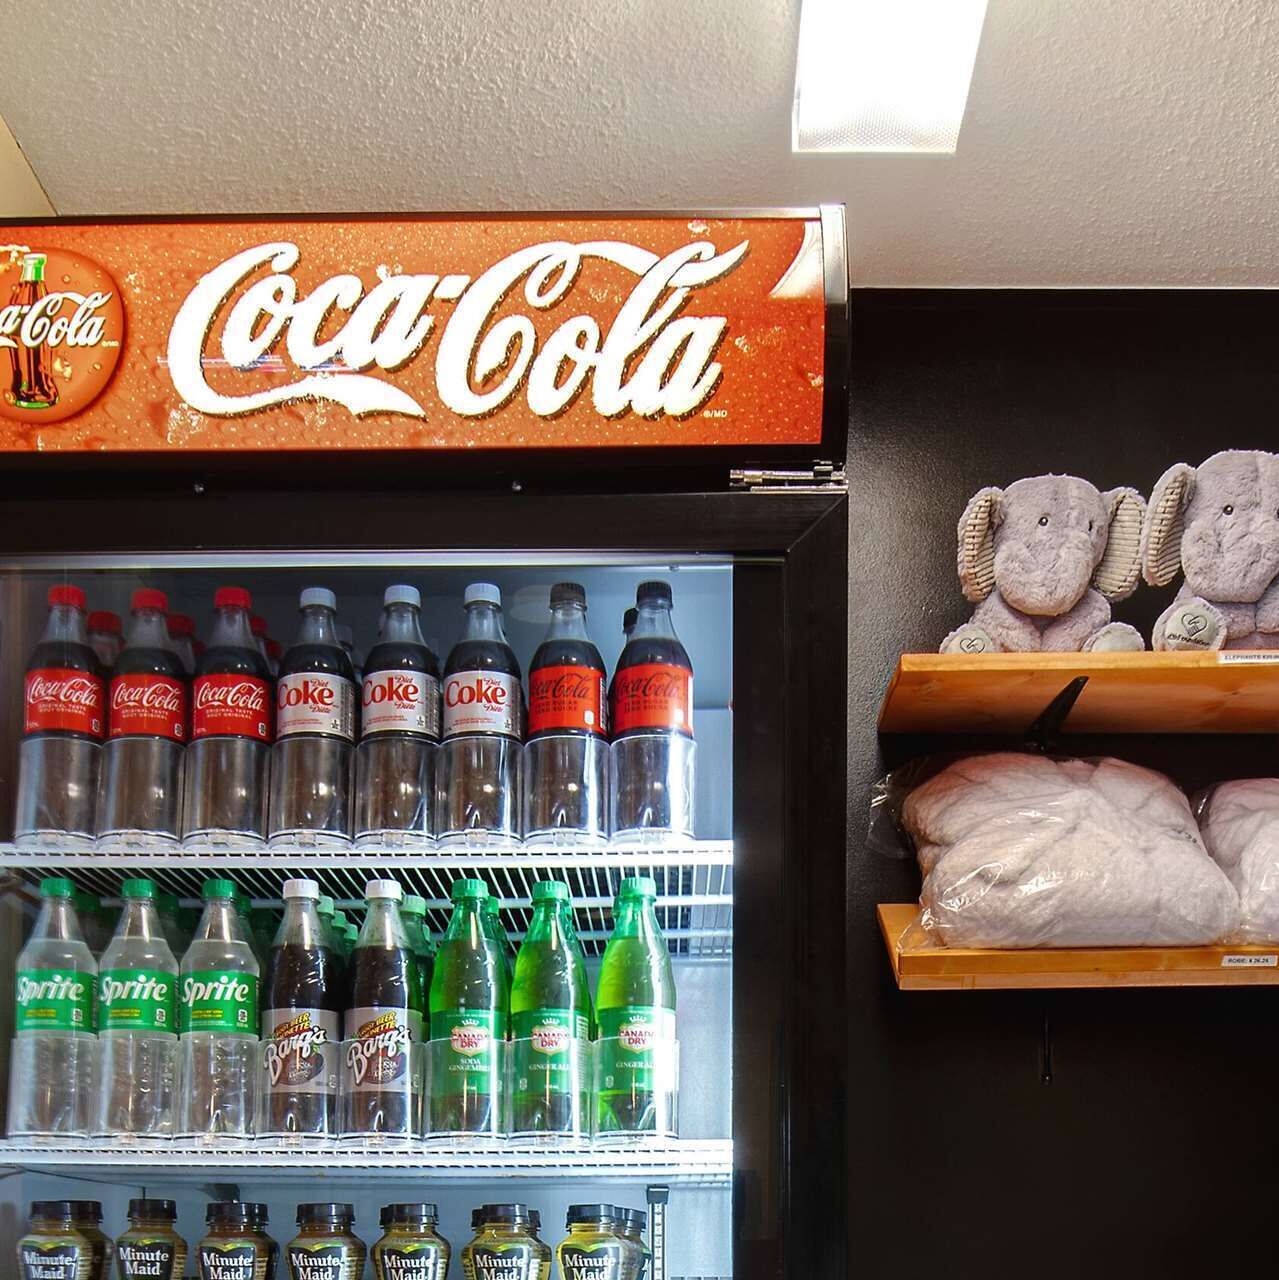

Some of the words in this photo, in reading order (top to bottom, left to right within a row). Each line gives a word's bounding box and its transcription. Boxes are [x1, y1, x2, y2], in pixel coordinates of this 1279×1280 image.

[168, 239, 750, 421] Coca-Cola
[29, 675, 99, 706] Coca-Cola
[112, 682, 181, 711] Coca-Cola
[196, 682, 266, 711] Coca-Cola
[277, 680, 335, 709] Coke
[362, 676, 419, 707] Coke
[445, 678, 506, 708] Coke
[18, 974, 84, 1008] Sprite
[100, 974, 167, 1007] Sprite
[182, 974, 249, 1008] Sprite
[460, 1038, 481, 1049] DRY
[540, 1038, 560, 1048] DRY
[628, 1036, 648, 1046] DRY
[263, 1026, 327, 1087] Barq's
[347, 1025, 412, 1086] Barq's
[24, 1250, 76, 1266] Minute
[120, 1247, 169, 1262] Minute
[203, 1252, 252, 1267] Minute
[291, 1252, 340, 1267] Minute
[384, 1254, 432, 1269] Minute
[476, 1254, 524, 1268] Minute
[564, 1254, 616, 1268] Minute
[31, 1265, 68, 1280] Maid
[126, 1261, 164, 1276] Maid
[210, 1266, 248, 1280] Maid
[300, 1266, 336, 1280] Maid
